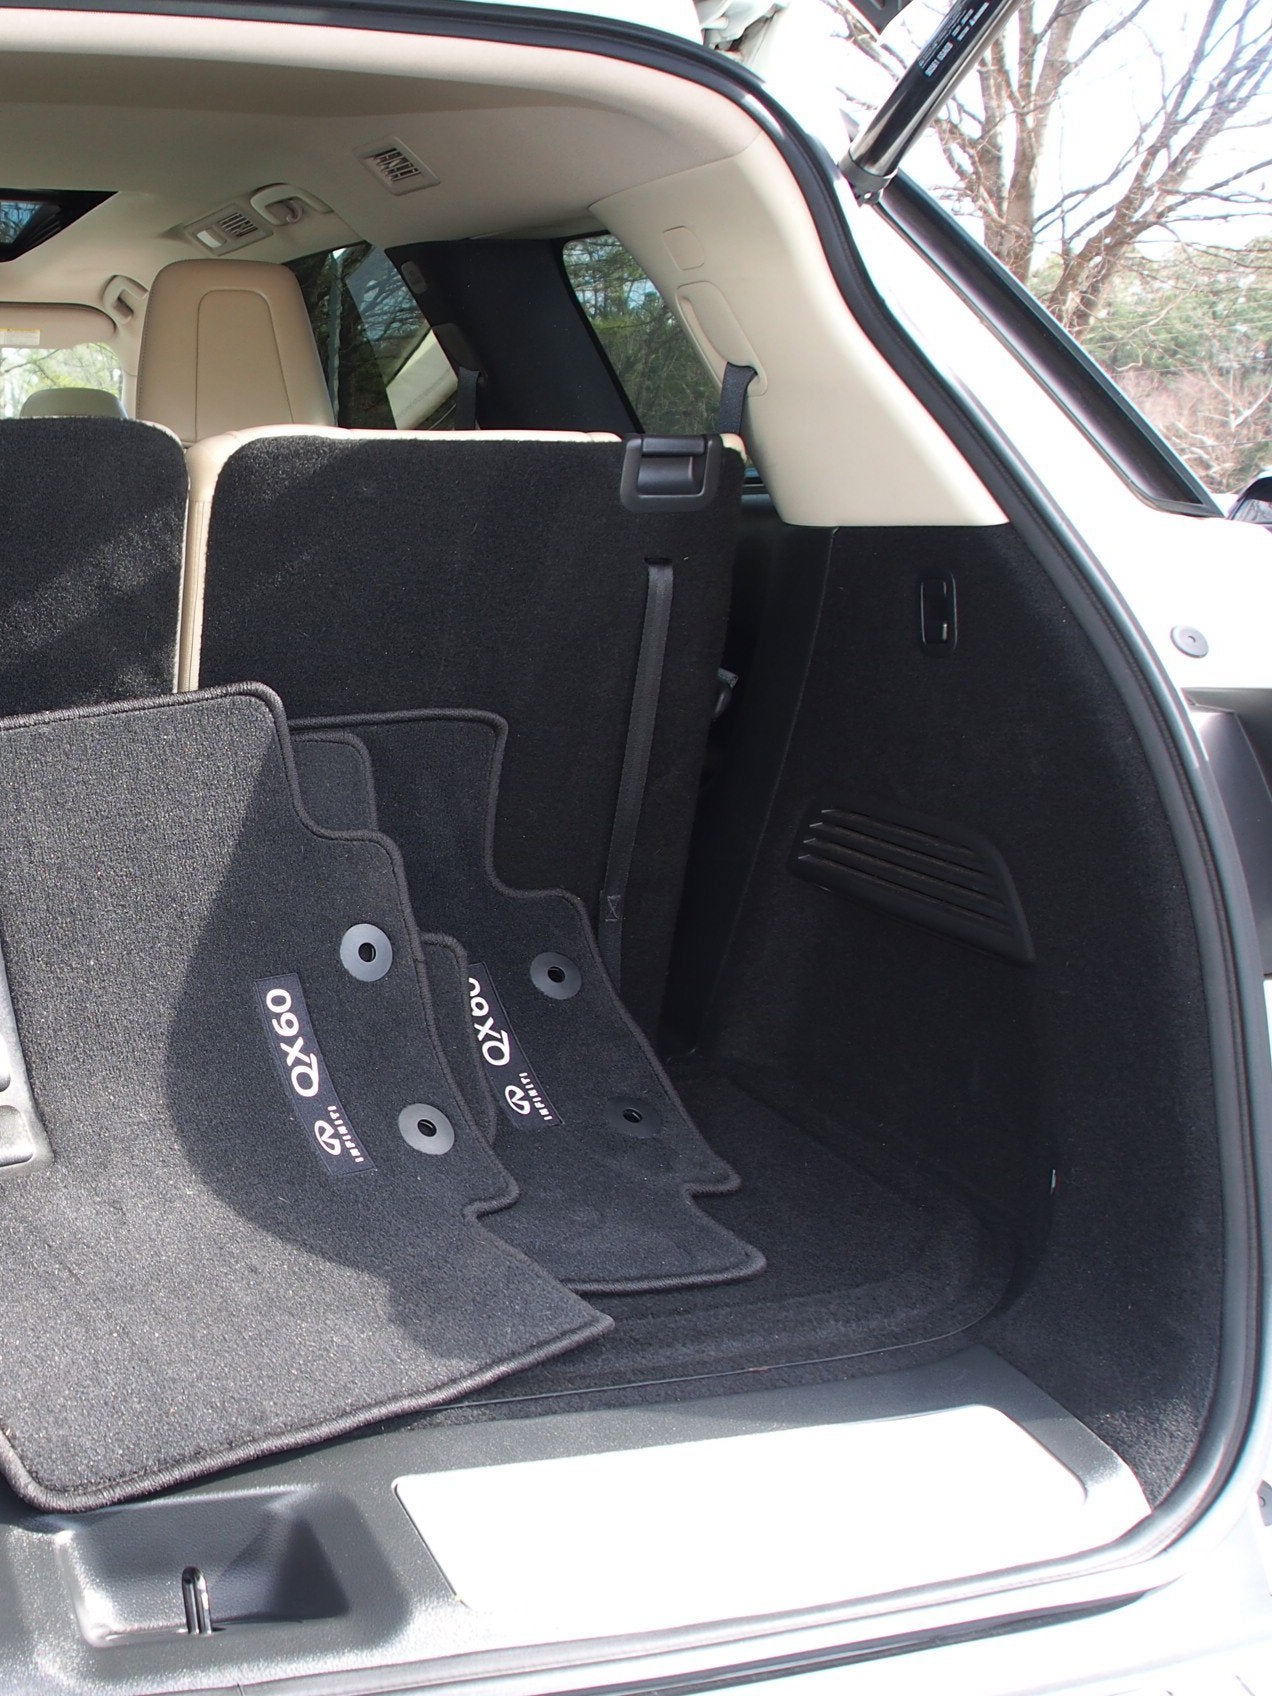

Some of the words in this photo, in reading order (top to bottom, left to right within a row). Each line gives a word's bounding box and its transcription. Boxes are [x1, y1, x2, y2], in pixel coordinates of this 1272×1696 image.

[265, 988, 320, 1098] QX60
[518, 1072, 553, 1121] INFINITI
[327, 1105, 365, 1163] INFINITI
